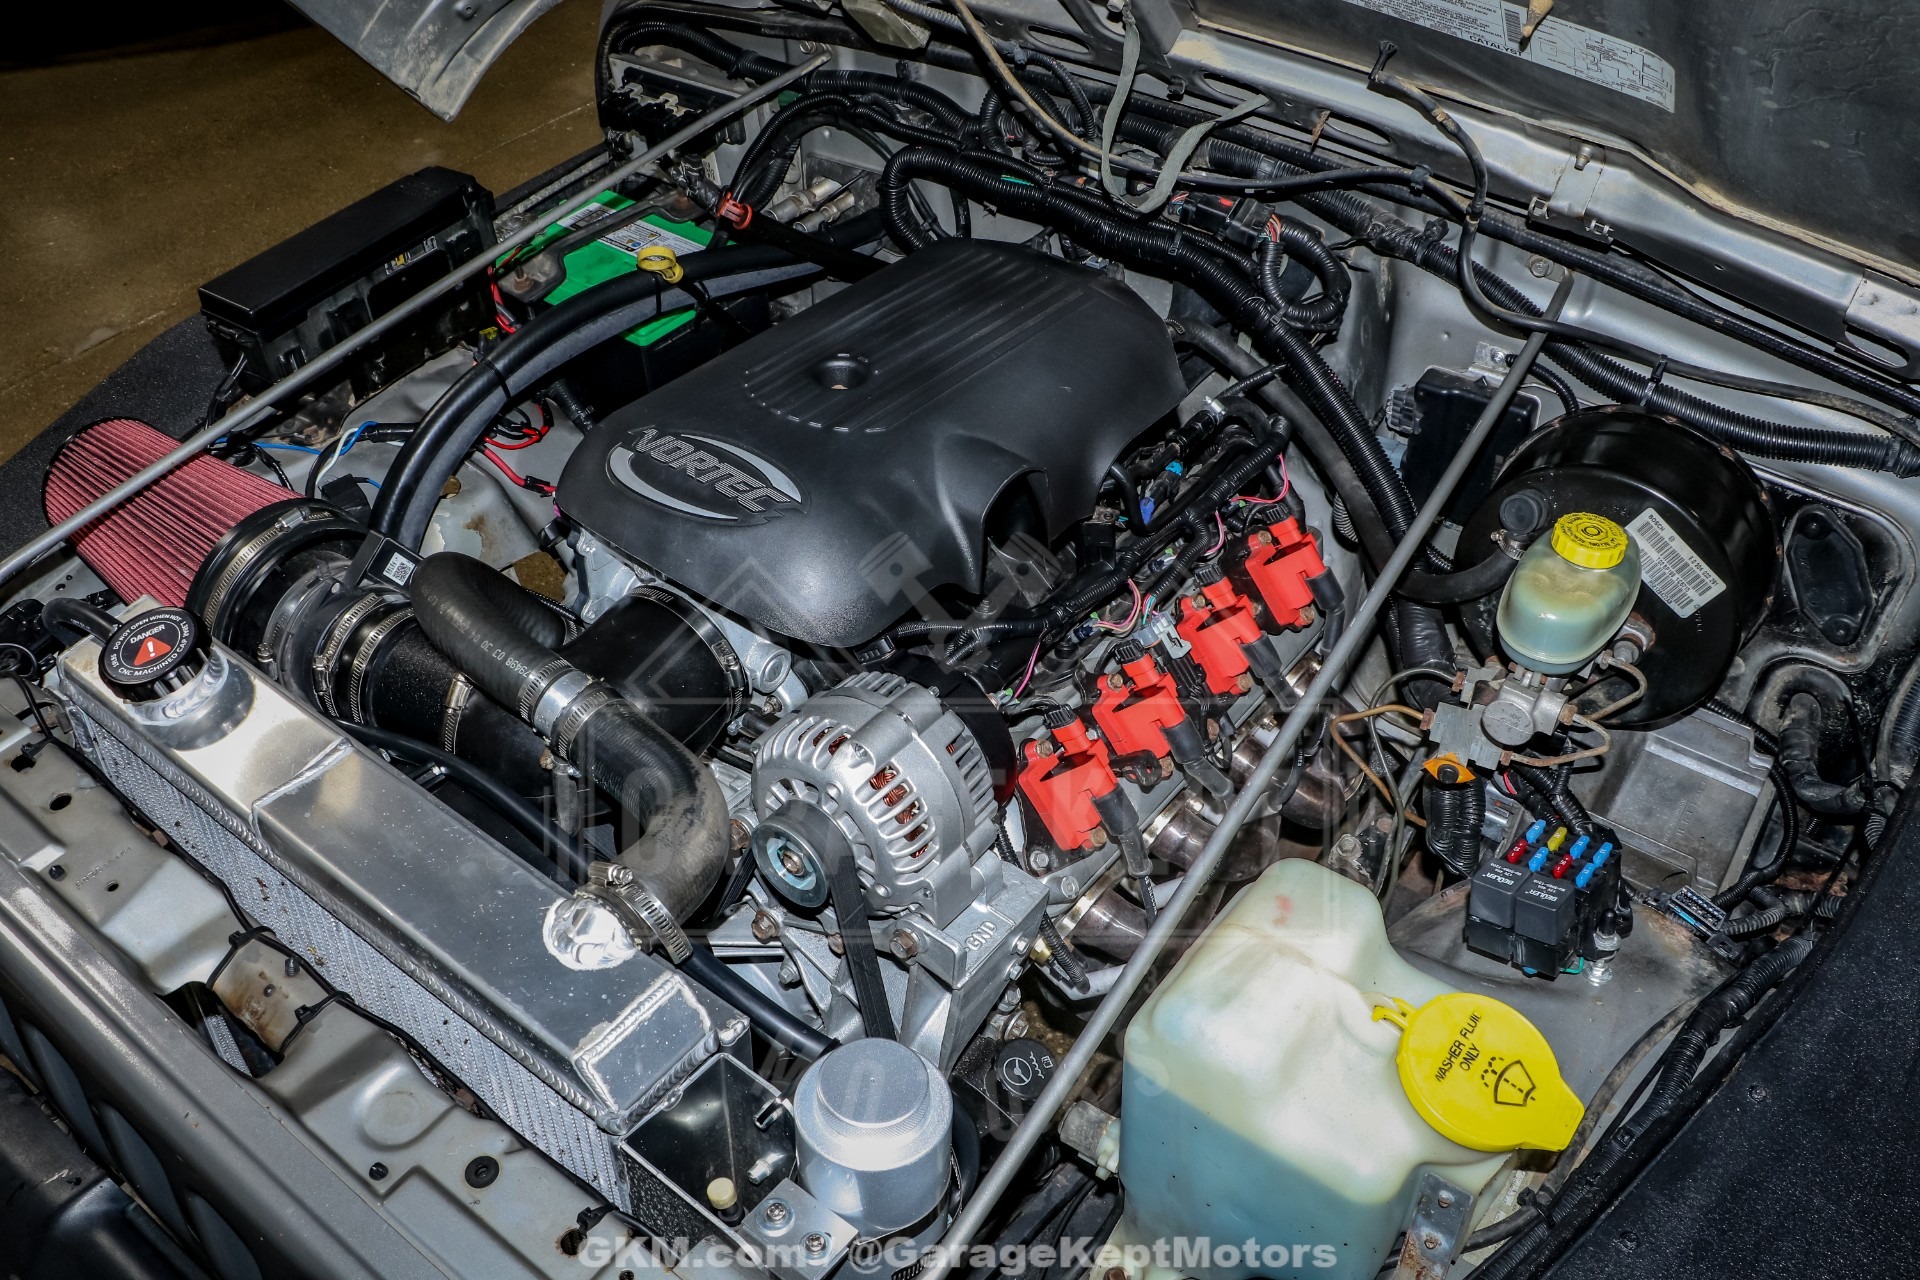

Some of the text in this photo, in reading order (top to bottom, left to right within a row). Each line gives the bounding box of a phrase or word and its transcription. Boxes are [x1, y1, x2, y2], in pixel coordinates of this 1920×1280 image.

[1469, 35, 1523, 57] CATALYST
[633, 428, 792, 513] VORTEC
[1648, 514, 1666, 532] BOSCH
[113, 641, 121, 650] DO
[120, 629, 131, 641] NOT
[130, 618, 149, 630] OPEN
[130, 624, 166, 644] DANGER
[118, 639, 188, 676] CNC MACHINED CAP
[965, 921, 997, 951] GND
[1435, 1039, 1466, 1082] WASHER
[1459, 1043, 1481, 1071] ONLY
